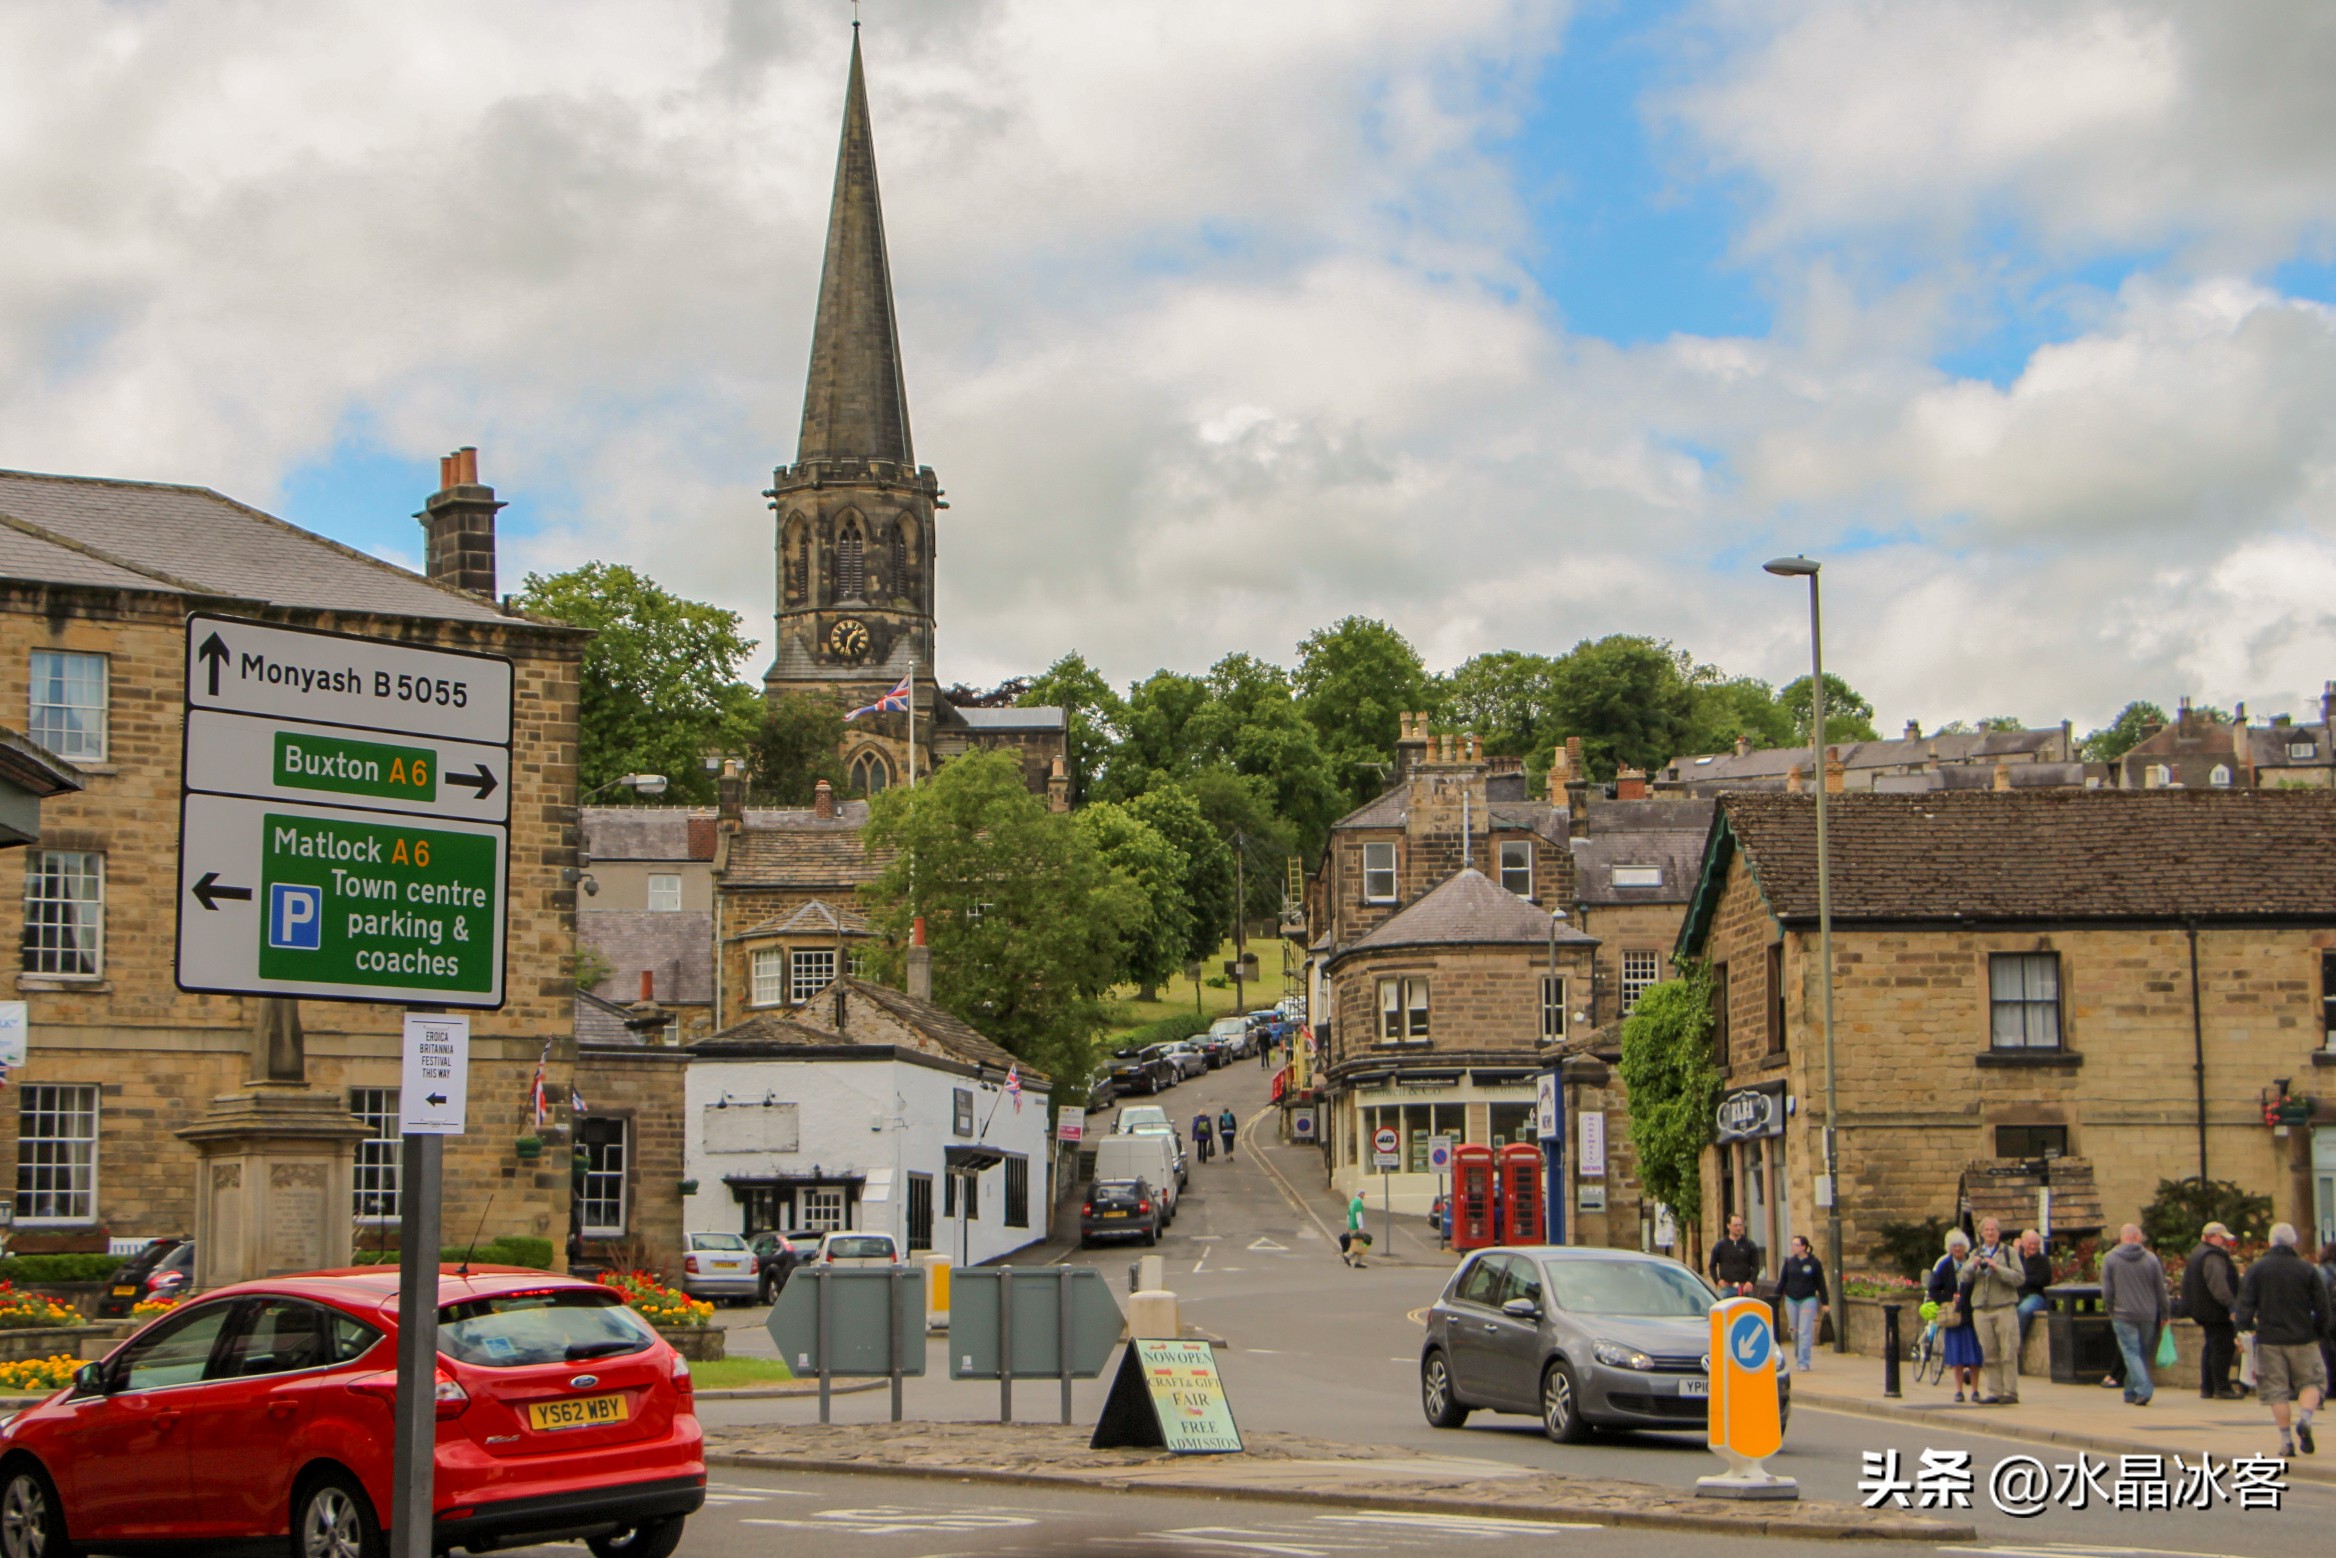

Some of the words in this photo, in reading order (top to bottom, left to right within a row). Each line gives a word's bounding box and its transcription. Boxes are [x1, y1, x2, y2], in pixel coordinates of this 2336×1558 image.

[241, 652, 361, 694] Monyash
[285, 744, 379, 782] Buxton
[389, 757, 427, 787] A6
[274, 826, 382, 863] Matlock
[391, 838, 430, 867] A6
[331, 868, 397, 900] Town
[406, 880, 486, 908] centre
[282, 891, 315, 942] P
[348, 910, 443, 945] parking
[453, 915, 469, 942] &
[355, 948, 459, 976] coaches
[426, 1031, 449, 1042] EROICA
[420, 1044, 454, 1054] BRITANNIA
[421, 1056, 451, 1067] FESTIVAL
[422, 1068, 437, 1079] THIS
[438, 1068, 451, 1079] WAY
[1409, 1085, 1417, 1096] &
[1144, 1351, 1176, 1364] NOW
[1177, 1352, 1213, 1364] OPEN
[1148, 1377, 1184, 1388] CRAFT
[1186, 1380, 1194, 1388] &
[1195, 1377, 1221, 1388] GIFT
[1173, 1392, 1210, 1406] FAIR
[538, 1403, 584, 1424] YS62
[587, 1398, 619, 1419] WBY
[1181, 1421, 1219, 1434] FREE
[1169, 1438, 1241, 1450] ADMISSION
